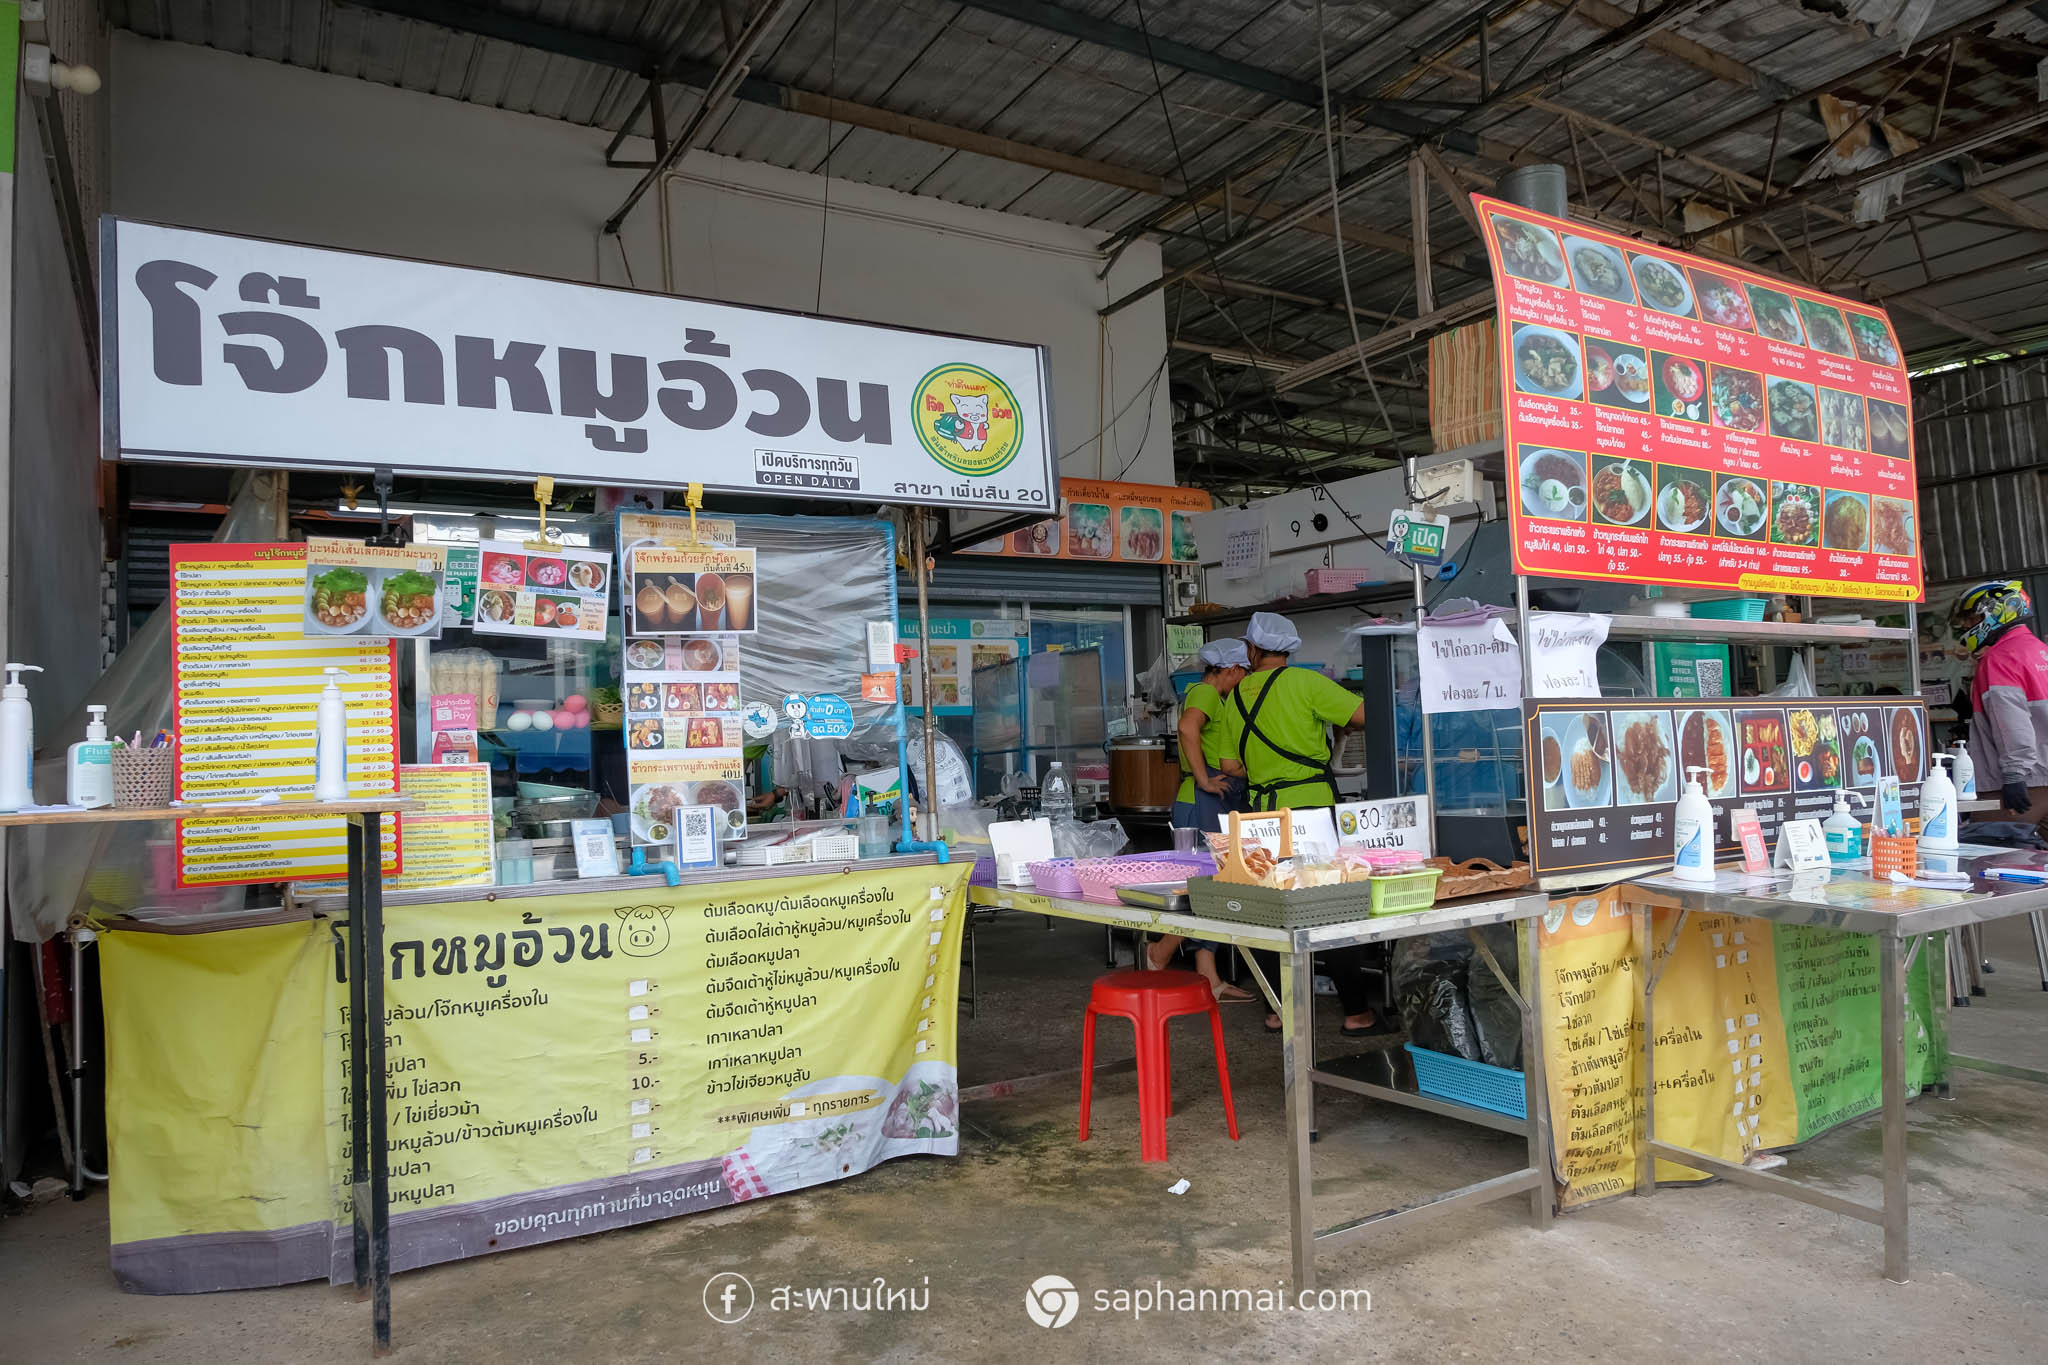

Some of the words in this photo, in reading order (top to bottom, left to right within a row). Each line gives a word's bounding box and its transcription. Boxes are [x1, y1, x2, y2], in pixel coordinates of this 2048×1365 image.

[136, 259, 893, 453] โจ๊กหมูอ้วน
[991, 402, 1013, 420] อ้วน
[761, 450, 853, 478] เปิดบริการทุกวัน
[763, 473, 803, 487] OPEN
[811, 476, 854, 490] DAILY
[893, 481, 944, 497] สาขา
[950, 479, 1011, 502] เพิ่มสิน
[1017, 487, 1045, 502] 20
[1310, 486, 1326, 502] 12
[1290, 520, 1301, 538] 9
[1411, 527, 1438, 548] เปิด
[634, 551, 738, 565] โจ๊กพร้อมถ้วยรักษ์โลก
[1442, 684, 1479, 701] ฟองละ
[1482, 680, 1491, 697] 7
[453, 711, 472, 722] Pay
[826, 724, 848, 734] 50%
[703, 887, 894, 921] ต้มเลือดหมู/ต้มเลือดหมูเครื่องใน
[704, 909, 912, 945] ต้มเลือดใส่เต้าหู้หมูล้วน/หมูเครื่องใน
[330, 911, 614, 989] โกหมูอ้วน
[705, 946, 801, 971] ต้มเลือดหมูปลา
[705, 956, 901, 996] ต้มจืดเต้าหู้ไข่หมูล้วน/หมูเครื่องใน
[705, 993, 818, 1021] ต้มจืดเต้าหู้หมูปลา
[706, 1023, 784, 1046] เกาเหลาปลา
[638, 1052, 659, 1067] 5.-
[707, 1045, 802, 1071] เกาเหลาหมูปลา
[413, 1078, 462, 1099] ไข่ลวก
[631, 1077, 661, 1091] 10.-
[706, 1067, 811, 1096] ข้าวไข่เจียวหมูสับ
[405, 1099, 481, 1124] ไข่เยี่ยวม้า
[812, 1093, 871, 1116] ทุกรายการ
[495, 1178, 722, 1238] ขอบคุณทุกท่านที่มาอุดหนุน
